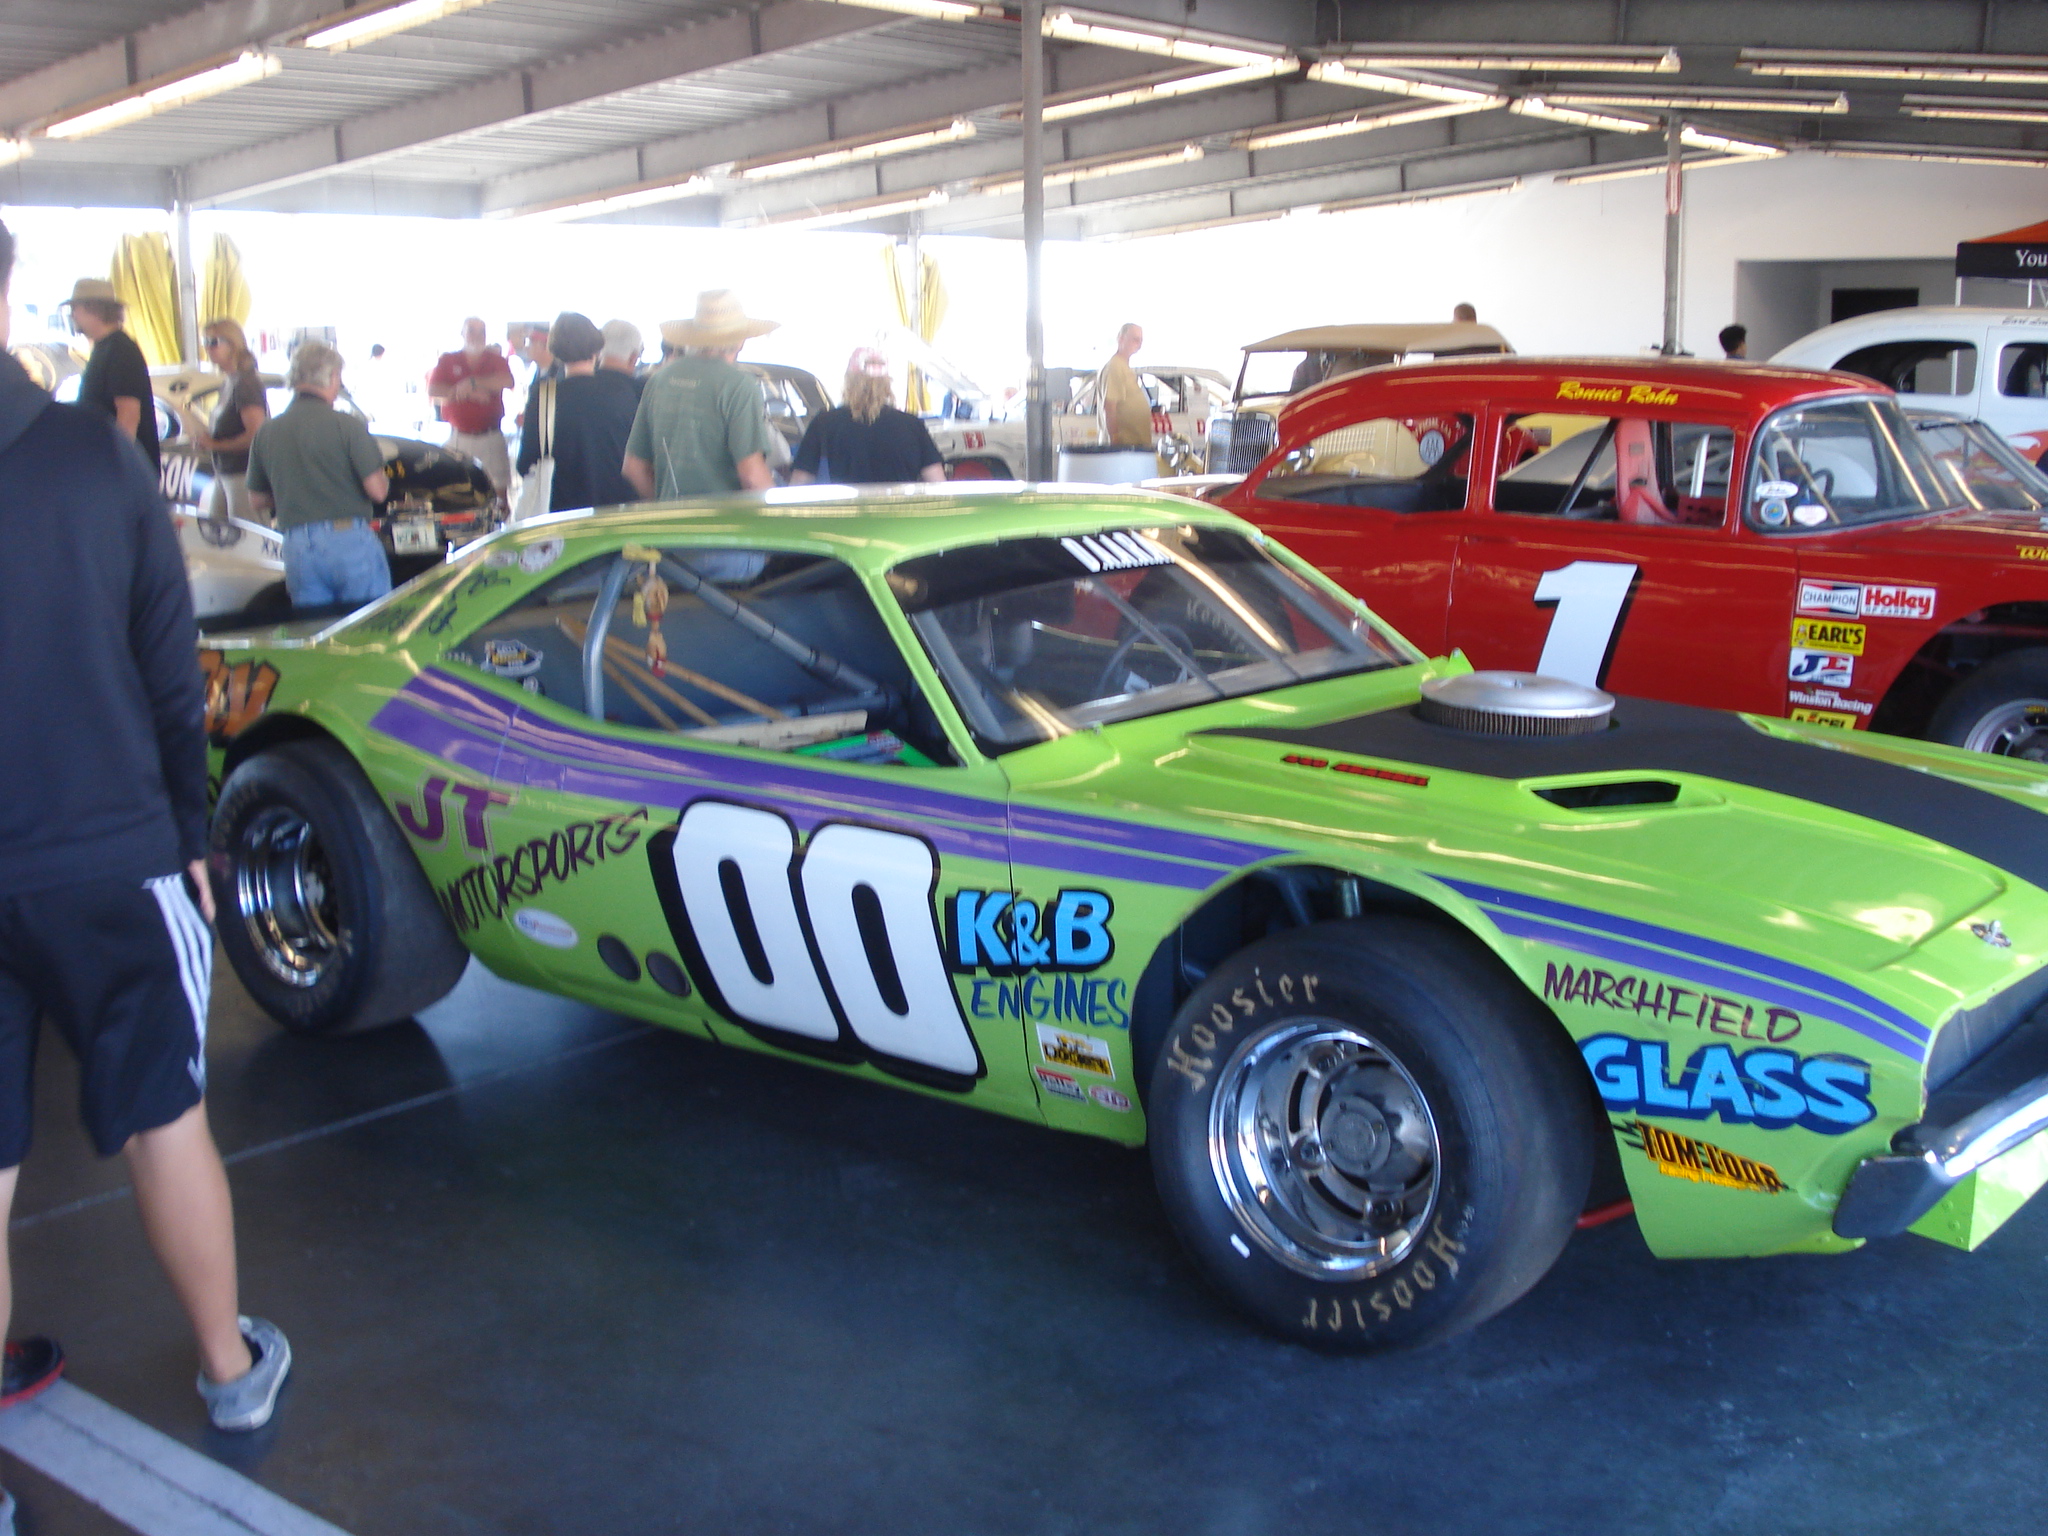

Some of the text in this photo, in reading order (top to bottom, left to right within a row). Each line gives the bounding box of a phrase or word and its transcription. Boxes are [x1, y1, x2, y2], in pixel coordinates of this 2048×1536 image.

[1556, 381, 1622, 402] Ronnie
[1534, 560, 1641, 690] 1
[1802, 589, 1857, 605] CHAMPION
[1865, 588, 1932, 615] Holley
[1808, 625, 1863, 645] EARL'S
[1832, 695, 1874, 716] Racing
[437, 804, 649, 934] MOTORSPORTS
[668, 798, 985, 1084] 00
[948, 888, 1114, 973] K&B
[970, 973, 1130, 1030] ENGINES
[1167, 966, 1321, 1094] Hoosier
[1543, 961, 1803, 1044] MARSHFIELD
[1578, 1033, 1876, 1135] GLASS
[1634, 1119, 1703, 1170] TOM
